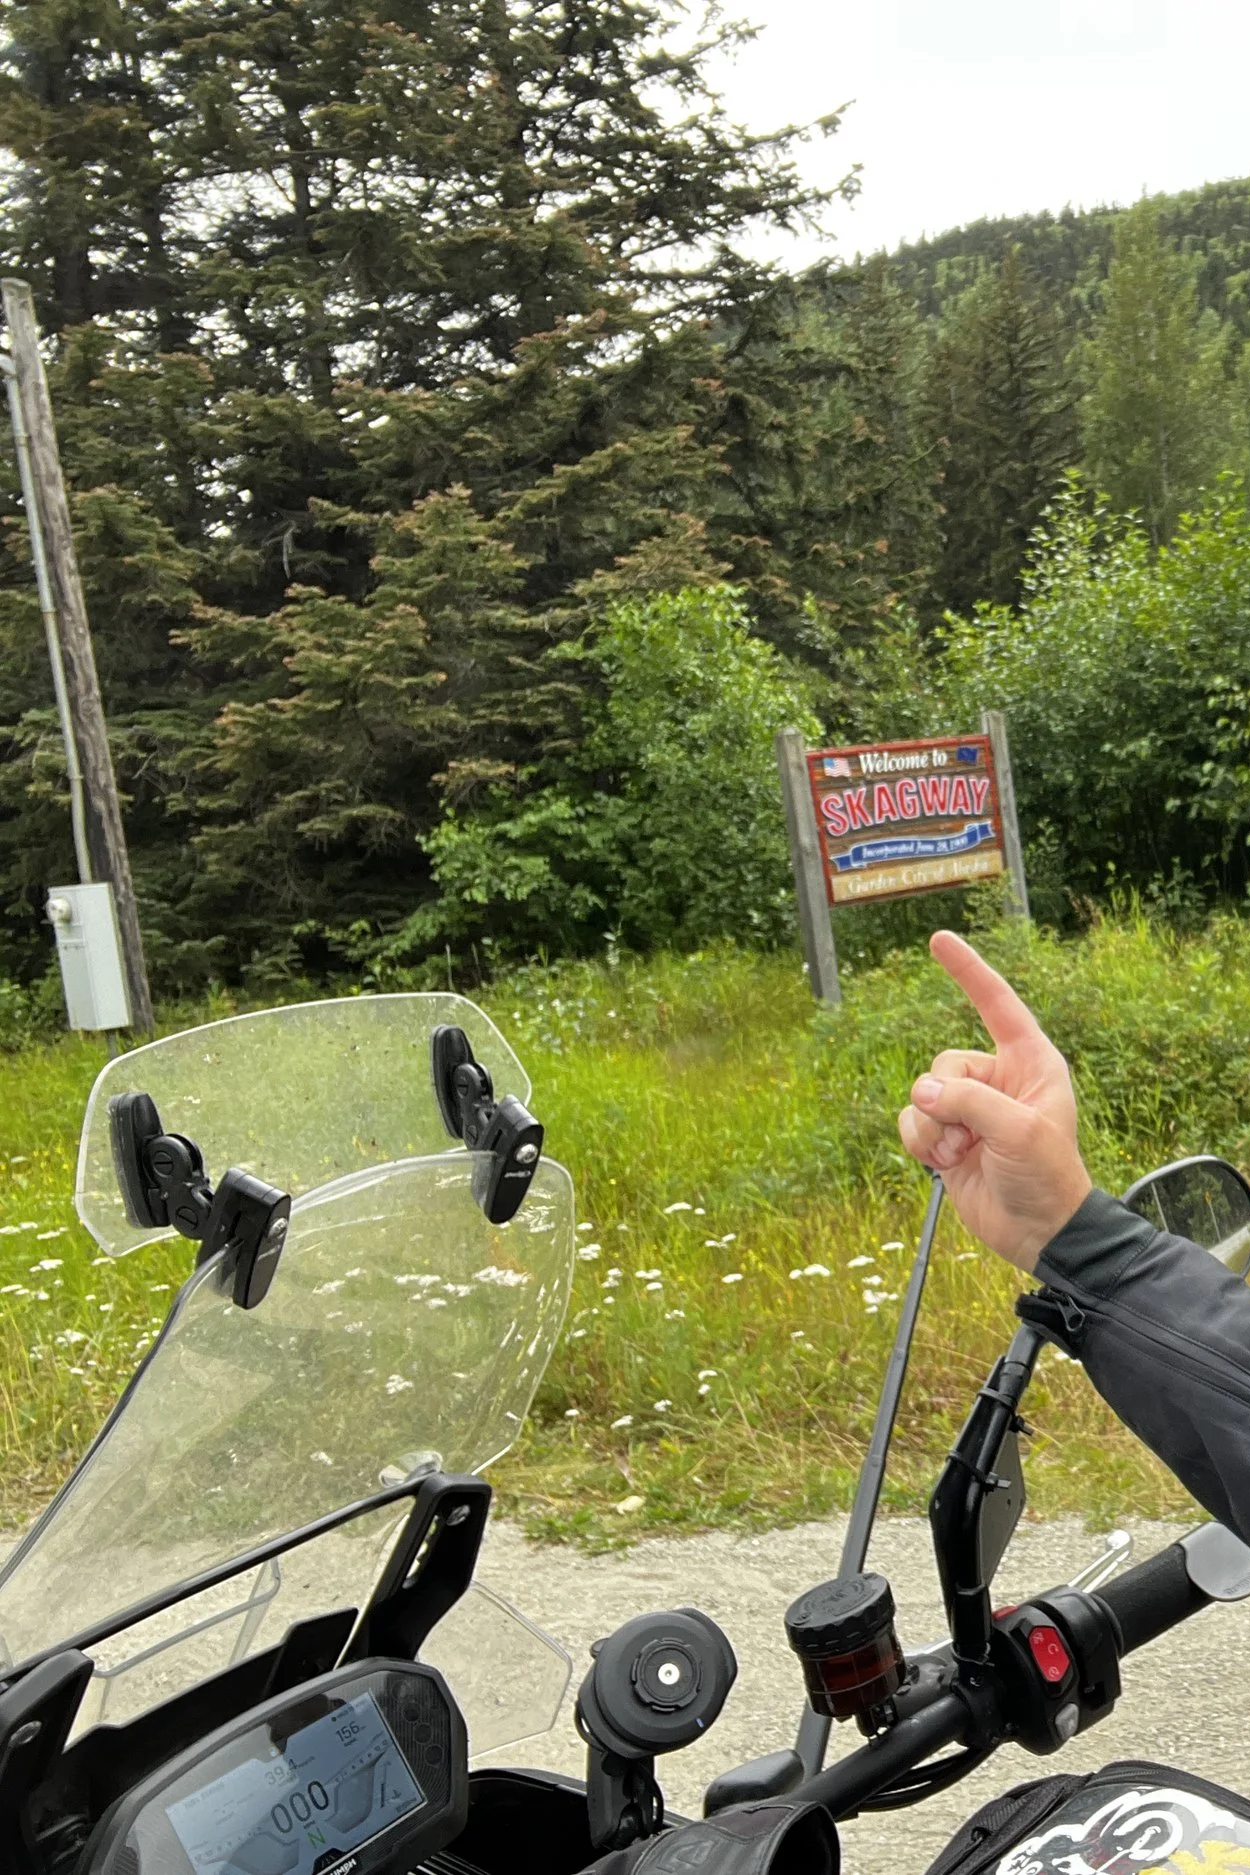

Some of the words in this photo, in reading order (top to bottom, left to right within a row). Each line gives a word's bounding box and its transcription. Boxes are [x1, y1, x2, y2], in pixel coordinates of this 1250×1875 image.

[859, 751, 928, 774] Welcome
[932, 748, 947, 767] to
[821, 776, 989, 836] SKAGWAY
[848, 874, 896, 894] Garden
[901, 866, 927, 886] City
[335, 1721, 360, 1742] 156
[271, 1781, 329, 1833] 000
[308, 1827, 326, 1849] N
